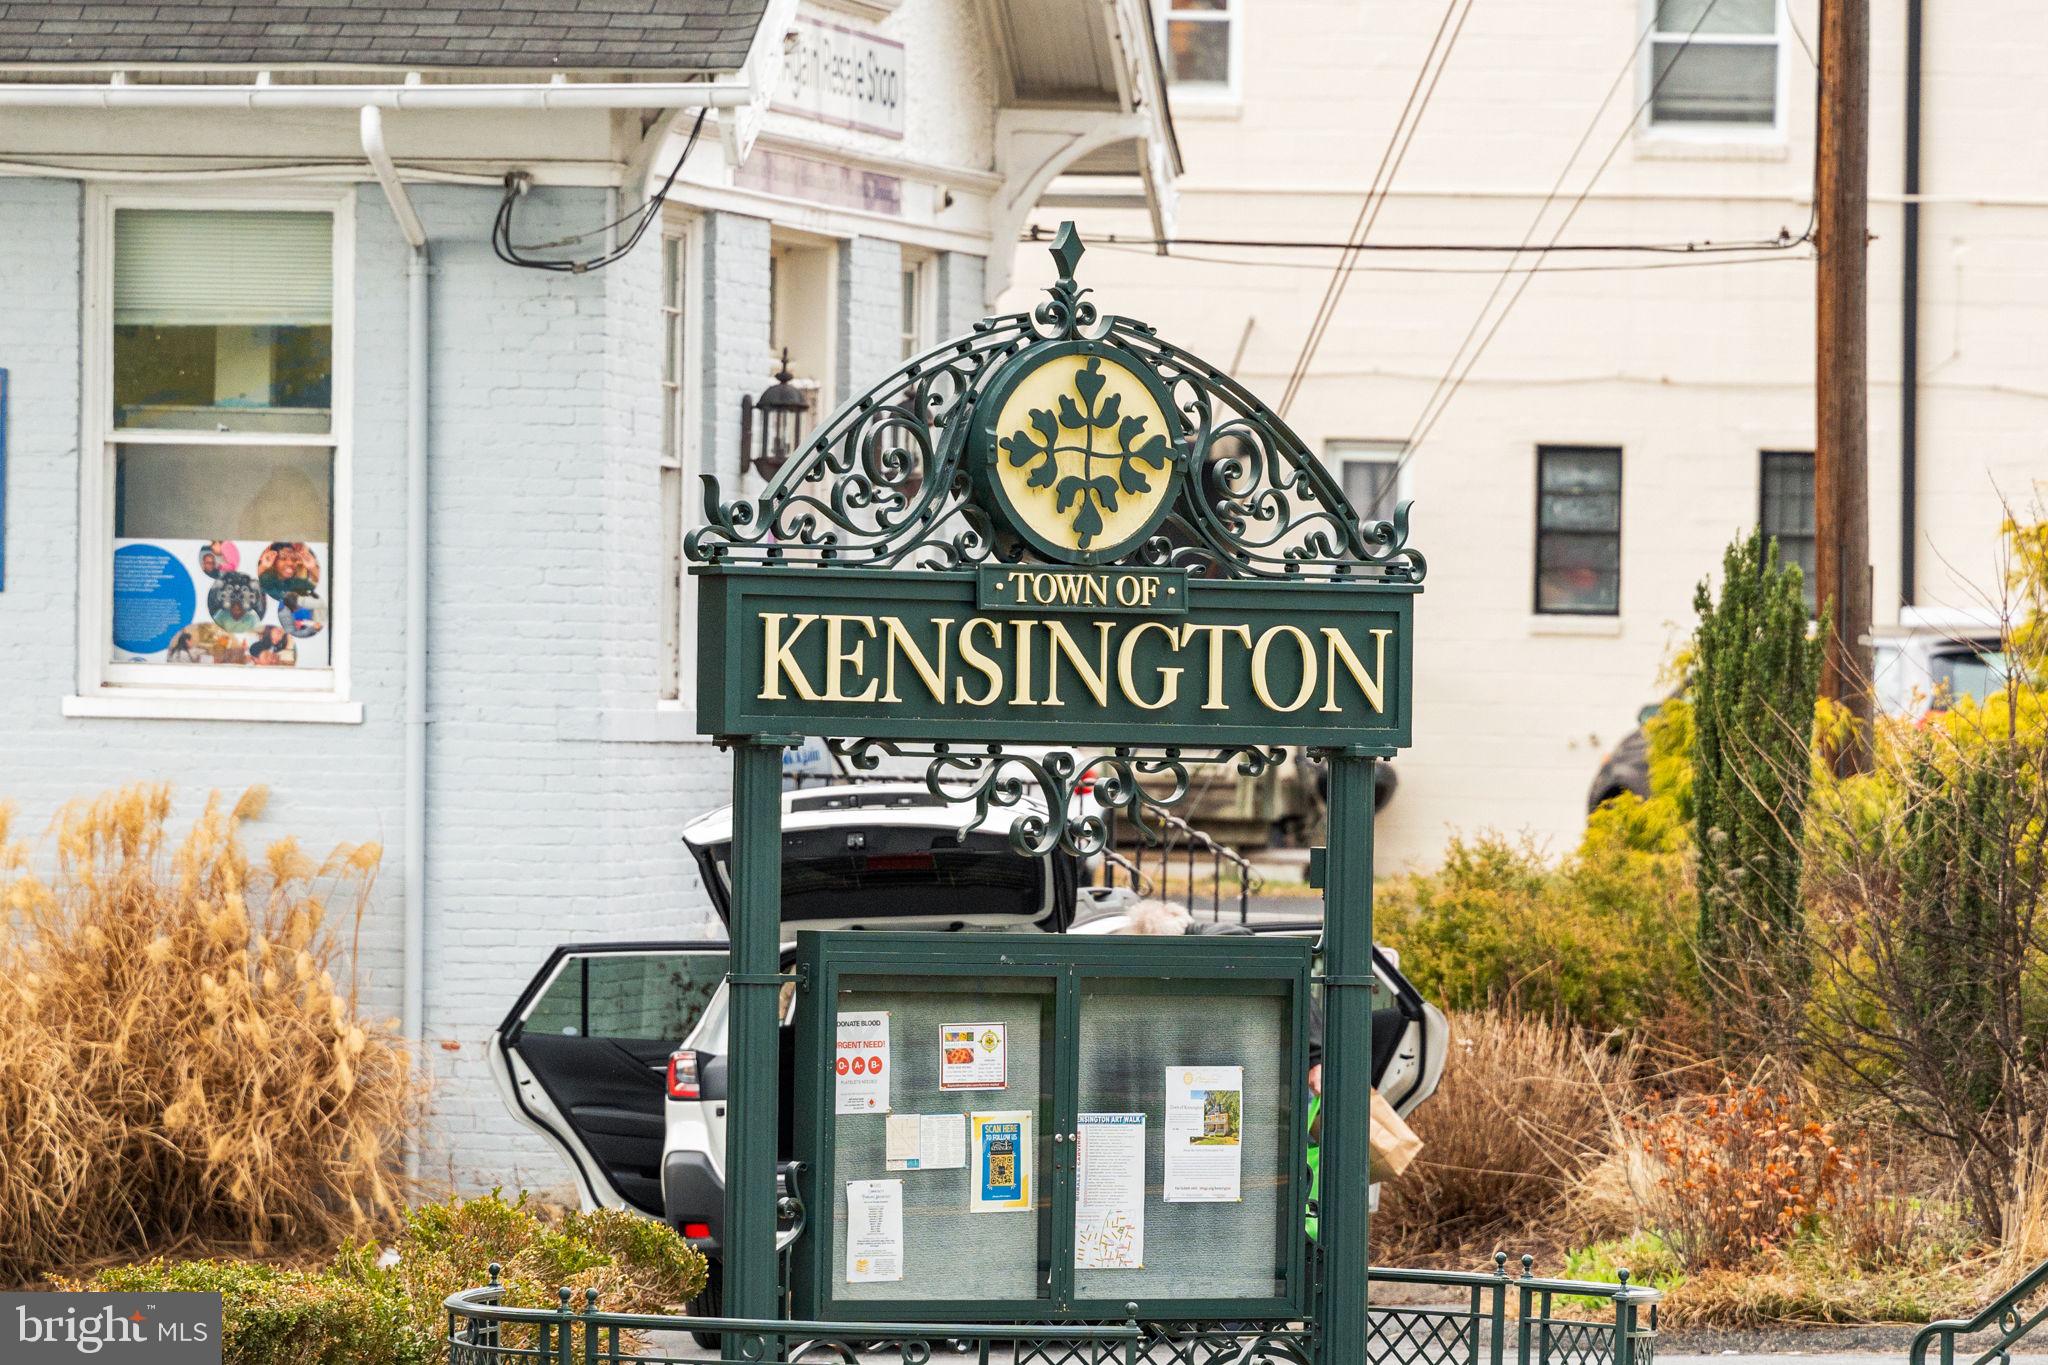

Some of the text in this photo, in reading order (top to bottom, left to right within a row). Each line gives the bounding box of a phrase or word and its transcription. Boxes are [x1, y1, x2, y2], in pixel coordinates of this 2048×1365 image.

[823, 37, 864, 100] Resale
[866, 49, 899, 122] Shop
[1008, 572, 1160, 606] TOWN OF
[757, 613, 1393, 714] KENSINGTON
[836, 1040, 886, 1049] RGENT NEED!
[1077, 1116, 1110, 1124] ENSINGTON
[1124, 1115, 1142, 1123] WALK
[985, 1124, 1018, 1134] SCAN HERE
[992, 1133, 1011, 1141] FOLLOW
